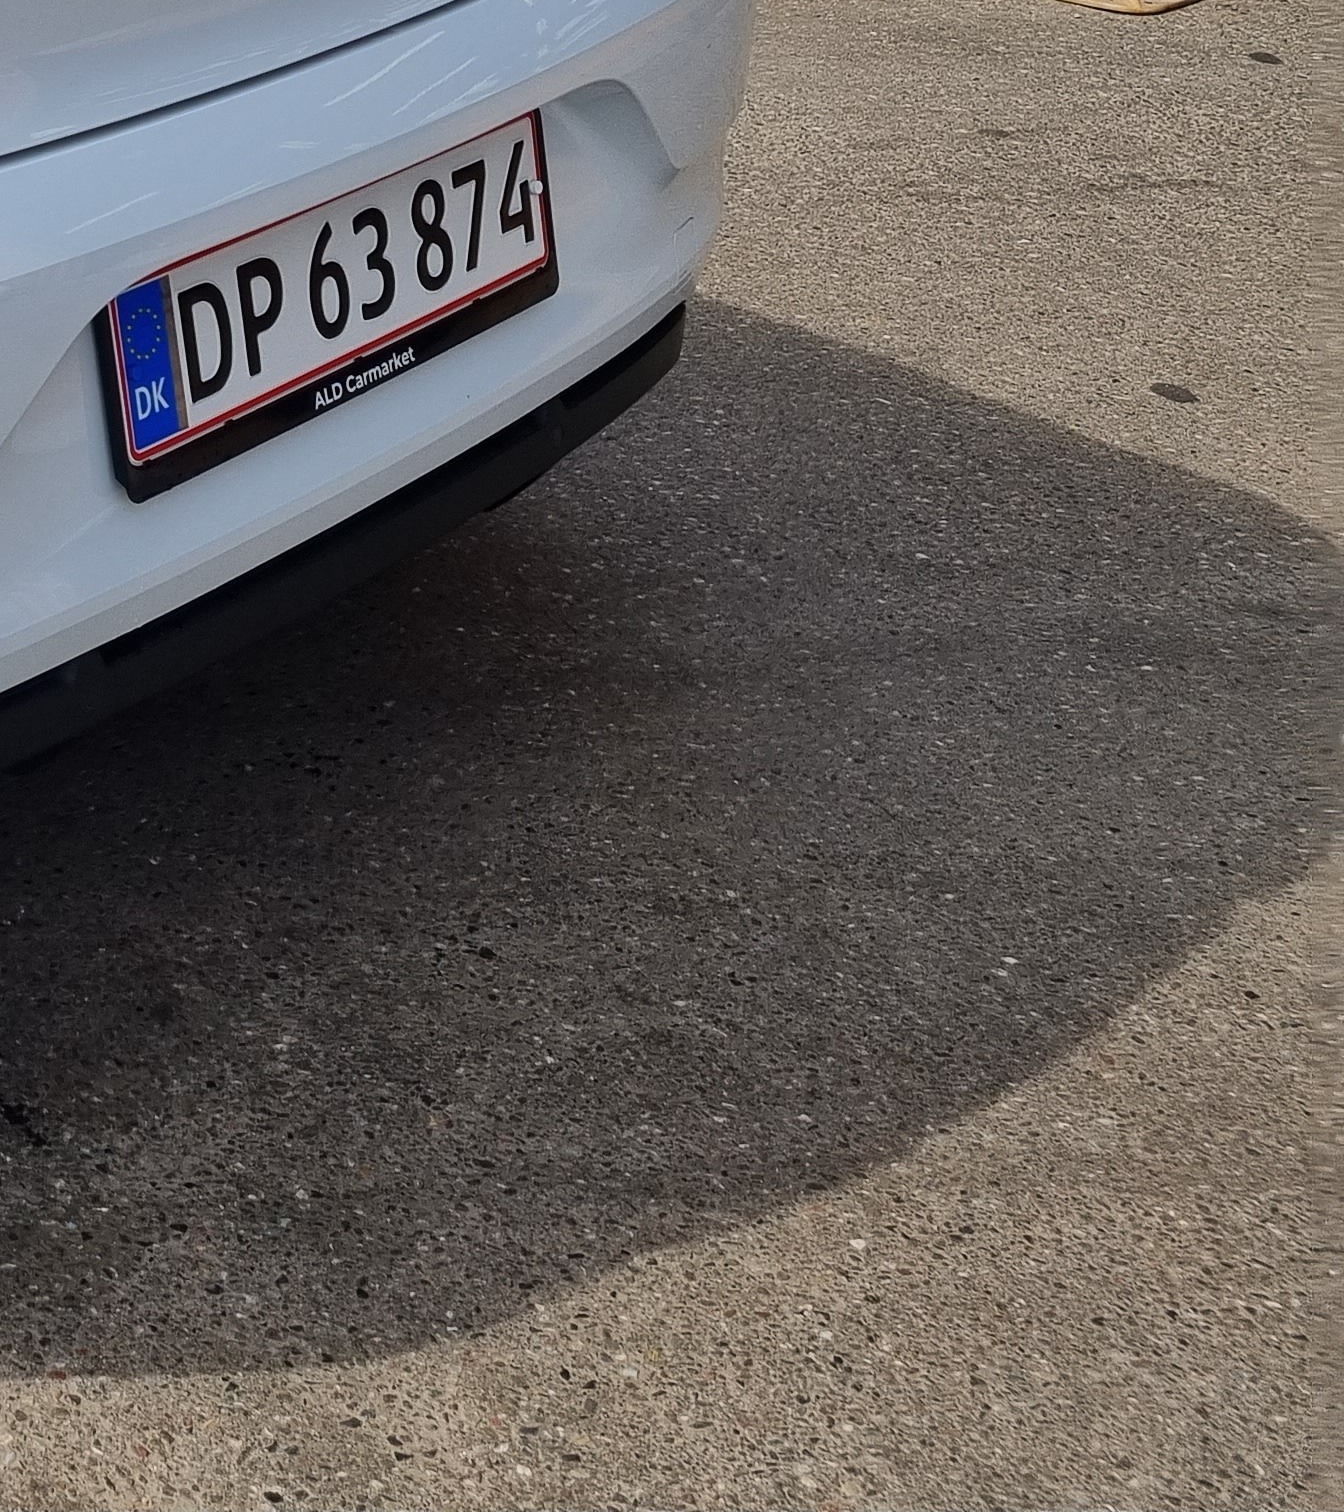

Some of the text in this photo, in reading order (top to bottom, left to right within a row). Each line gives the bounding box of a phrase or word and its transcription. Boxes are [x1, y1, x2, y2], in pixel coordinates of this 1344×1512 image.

[178, 139, 535, 404] DP 63 874
[135, 375, 170, 422] DK
[314, 345, 416, 410] ALD Carmarket
